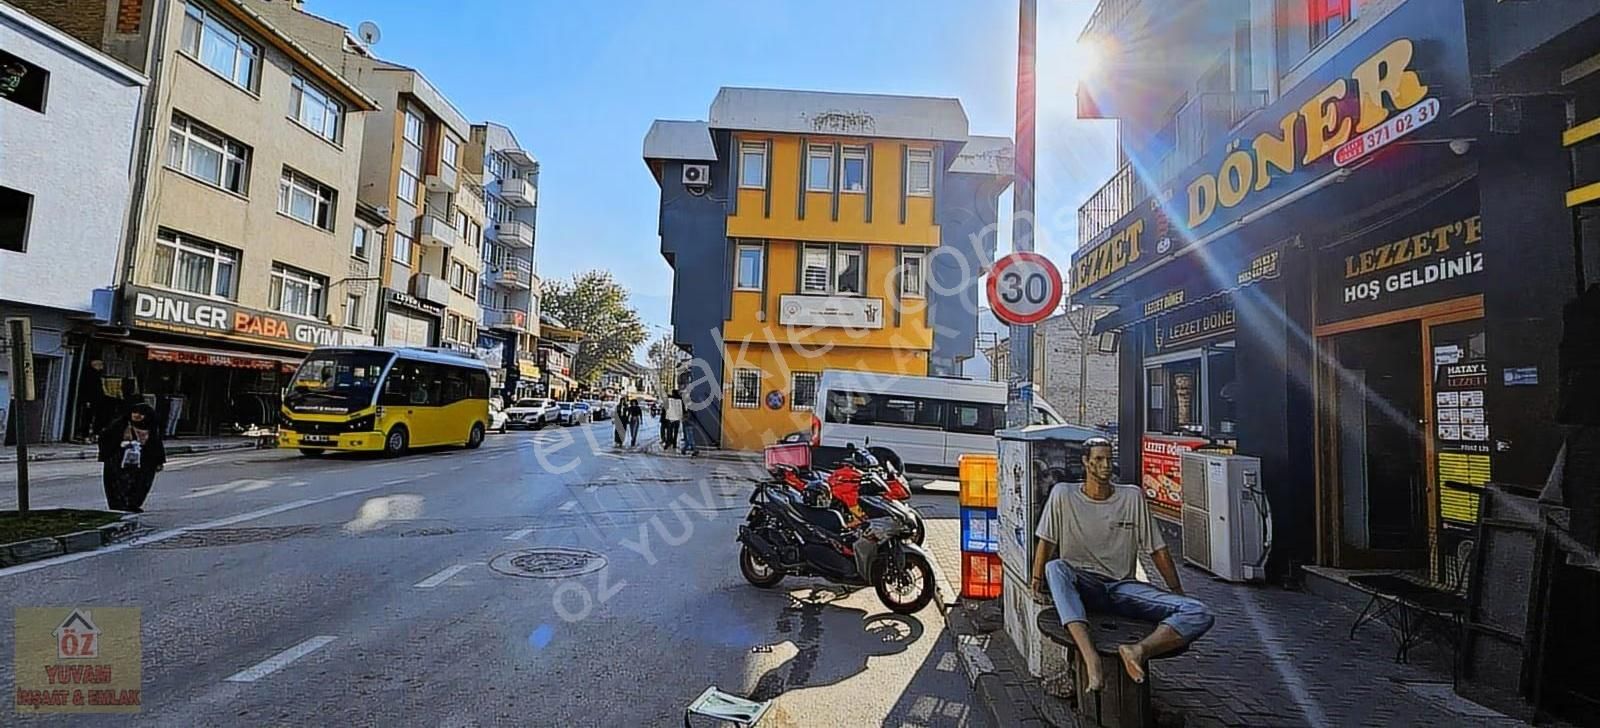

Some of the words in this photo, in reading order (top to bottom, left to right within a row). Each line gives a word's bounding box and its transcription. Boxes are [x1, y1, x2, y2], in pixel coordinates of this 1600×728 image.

[1187, 38, 1427, 228] DÖNER
[1367, 126, 1390, 148] 371
[1396, 114, 1414, 133] 02
[1419, 101, 1435, 122] 31
[1070, 219, 1144, 294] LEZZET
[1345, 280, 1380, 302] HOŞ
[1385, 251, 1483, 292] GELDİNİZ
[1001, 272, 1047, 304] 30
[234, 311, 289, 339] BABA
[1448, 364, 1479, 375] HATAY
